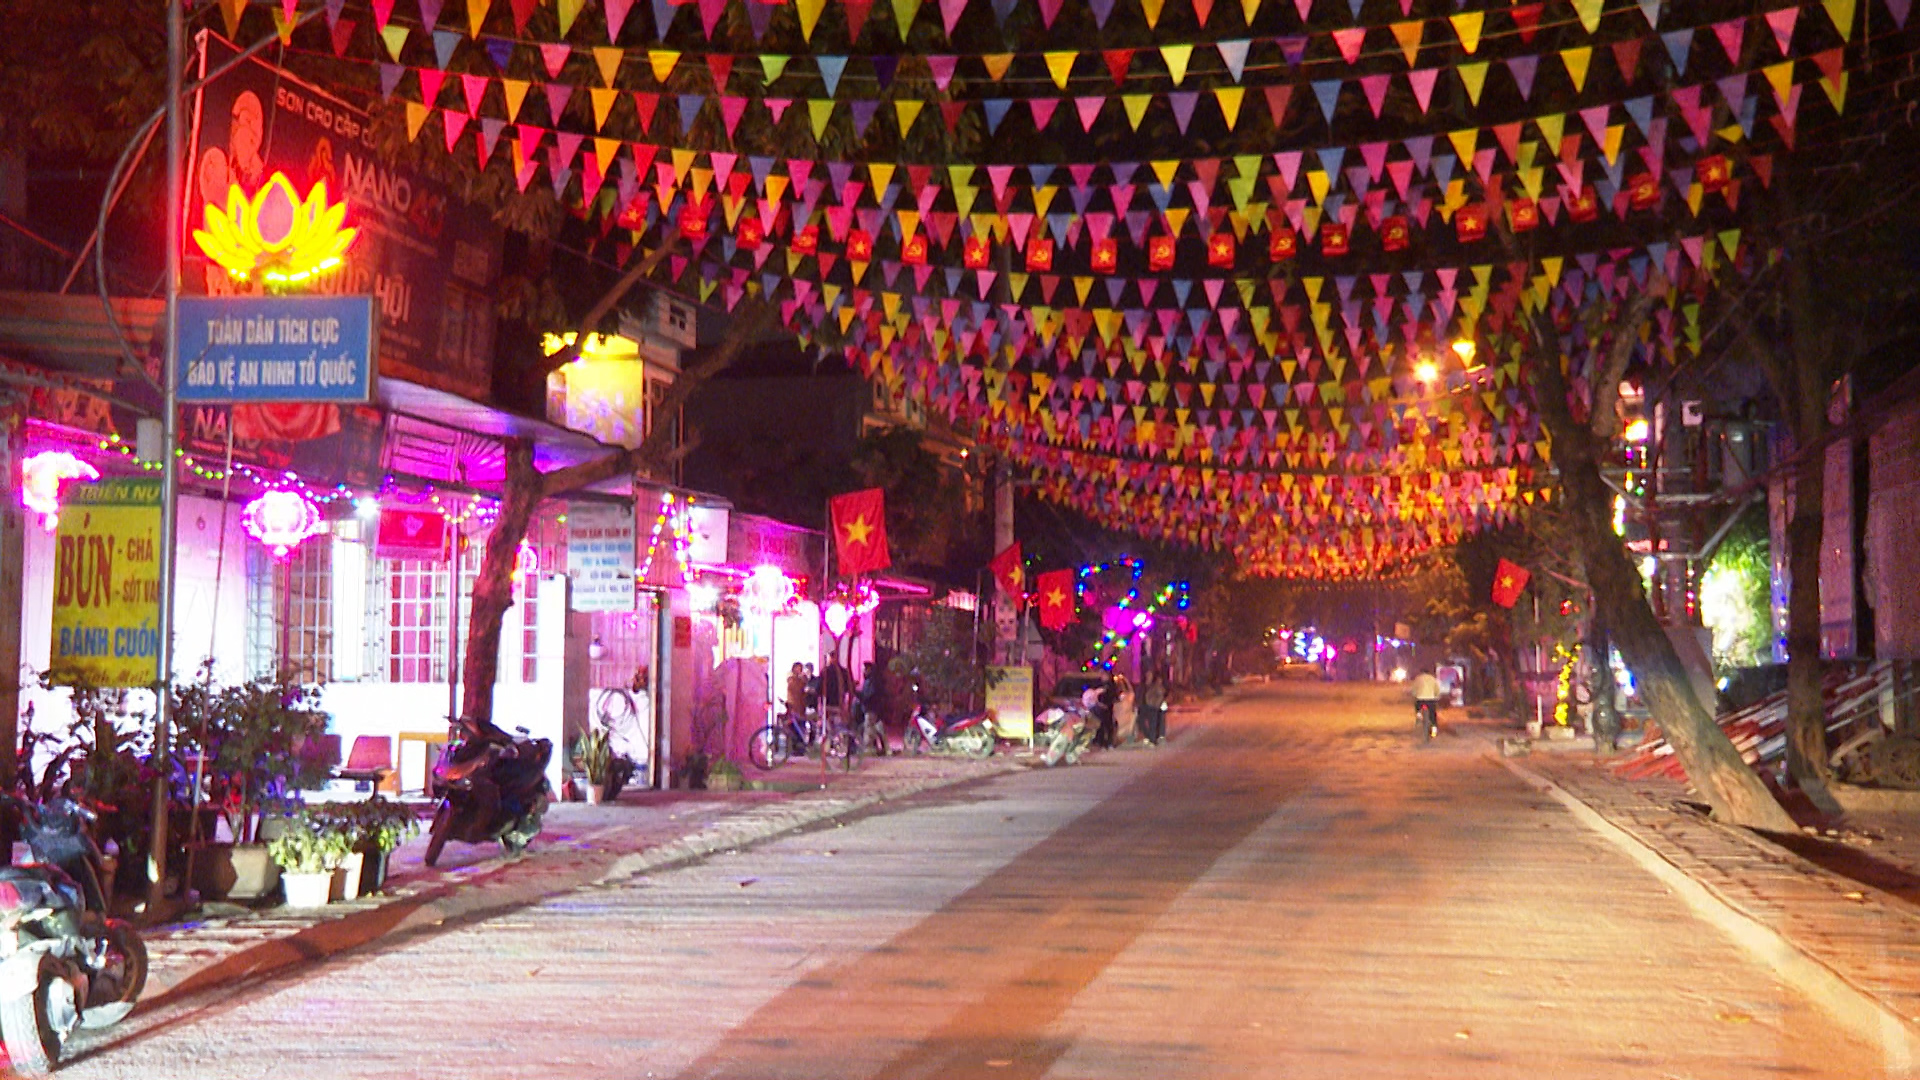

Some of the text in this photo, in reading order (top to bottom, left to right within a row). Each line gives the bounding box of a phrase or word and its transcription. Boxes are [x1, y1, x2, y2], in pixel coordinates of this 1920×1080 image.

[343, 152, 411, 213] NANO
[207, 313, 340, 349] TOÀN DÂN TÍCH CỰC
[219, 355, 235, 392] VỆ
[238, 360, 259, 386] AN
[261, 360, 296, 386] NINH
[299, 350, 317, 386] TỔ
[319, 351, 357, 389] QUỐC
[57, 512, 115, 609] BÚN
[59, 620, 110, 658] BÁNH
